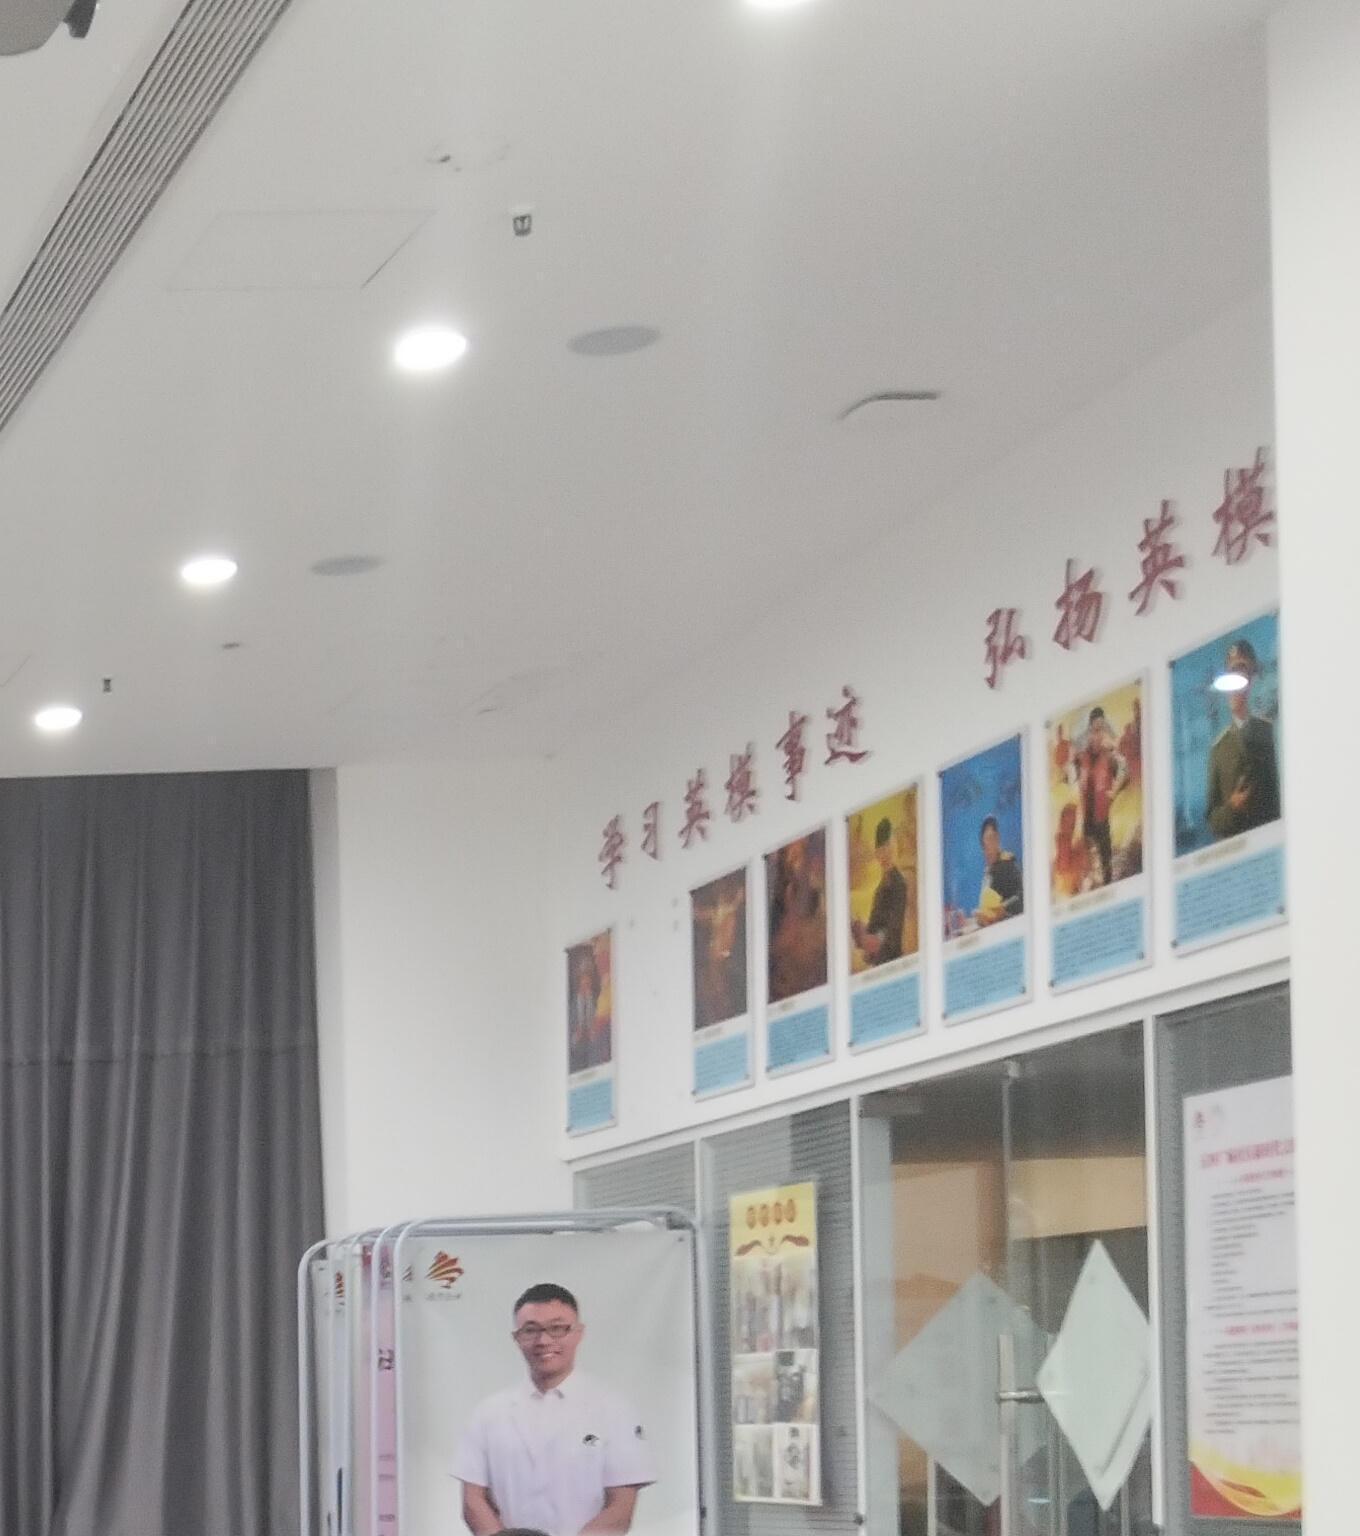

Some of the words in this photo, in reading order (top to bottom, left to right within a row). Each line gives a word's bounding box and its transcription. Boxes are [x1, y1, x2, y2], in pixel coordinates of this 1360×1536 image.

[598, 685, 871, 889] 学习英模事迹
[983, 446, 1274, 689] 弘扬英模
